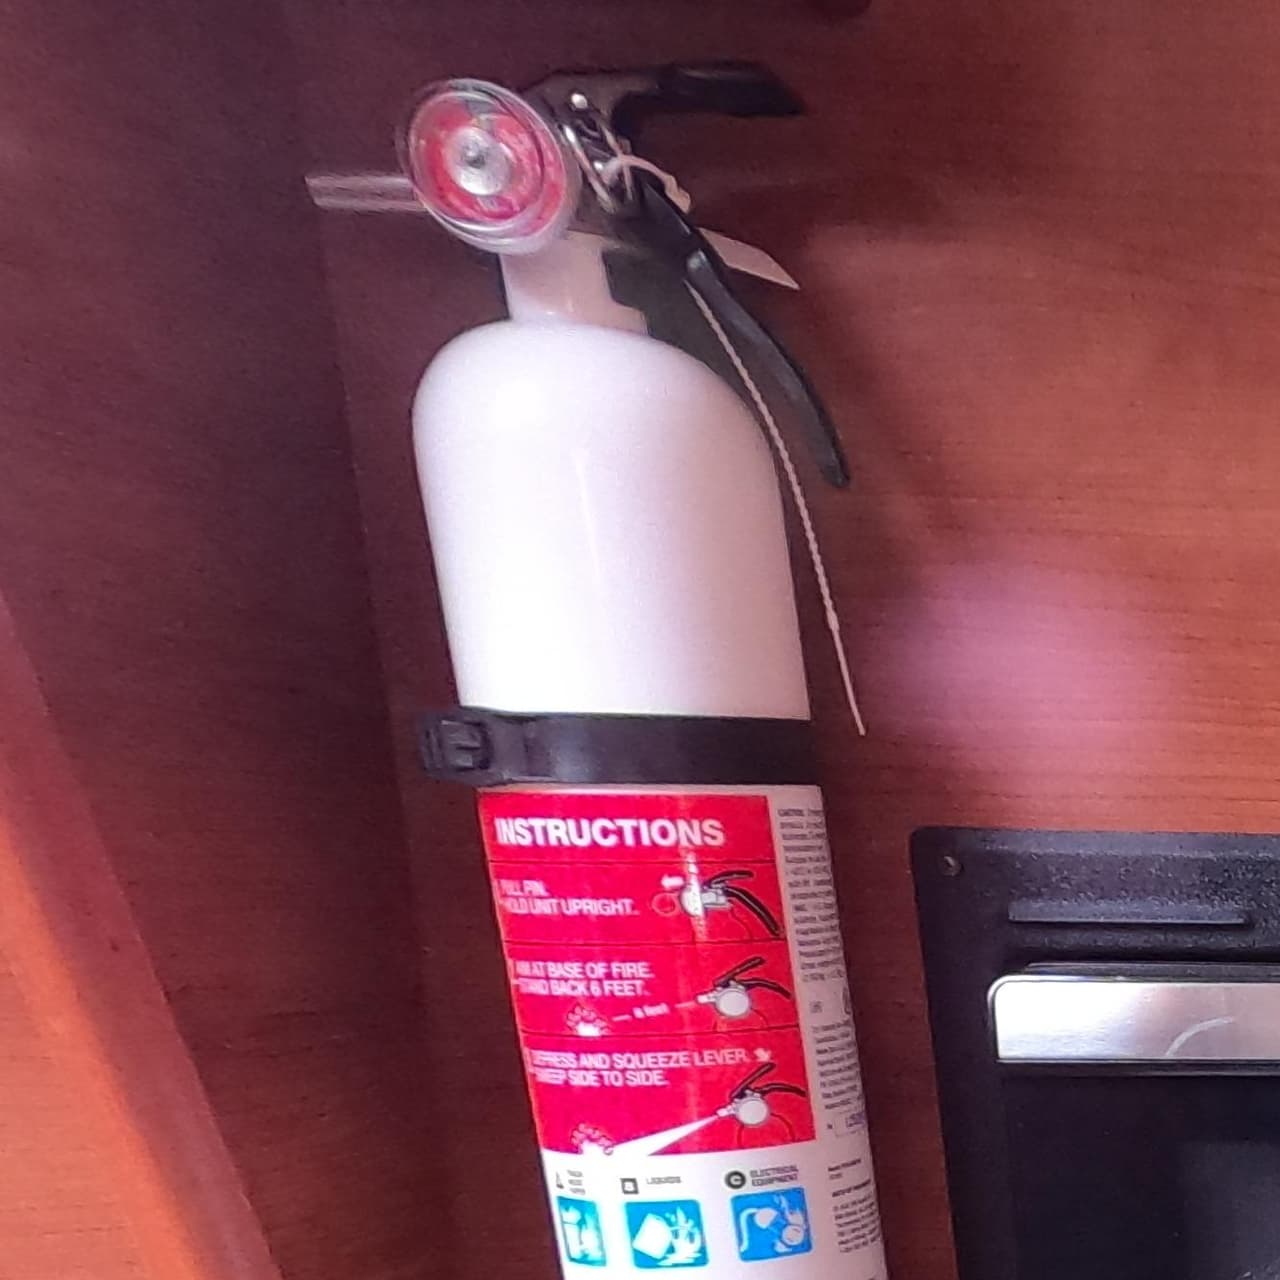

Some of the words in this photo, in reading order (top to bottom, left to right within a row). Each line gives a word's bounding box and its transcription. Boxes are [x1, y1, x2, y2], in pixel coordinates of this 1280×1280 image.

[494, 816, 726, 847] INSTRUCTIONS
[559, 898, 641, 916] UPRIGHT.
[547, 962, 584, 978] BASE
[585, 962, 608, 978] OF
[611, 962, 654, 978] FIRE.
[549, 979, 589, 996] BACK
[590, 980, 602, 996] 6
[603, 980, 652, 997] FEET.
[578, 1052, 611, 1069] AND
[612, 1050, 691, 1070] SQUEEZE
[568, 1069, 601, 1087] SIDE
[601, 1070, 623, 1087] TO
[625, 1069, 670, 1088] SIDE.
